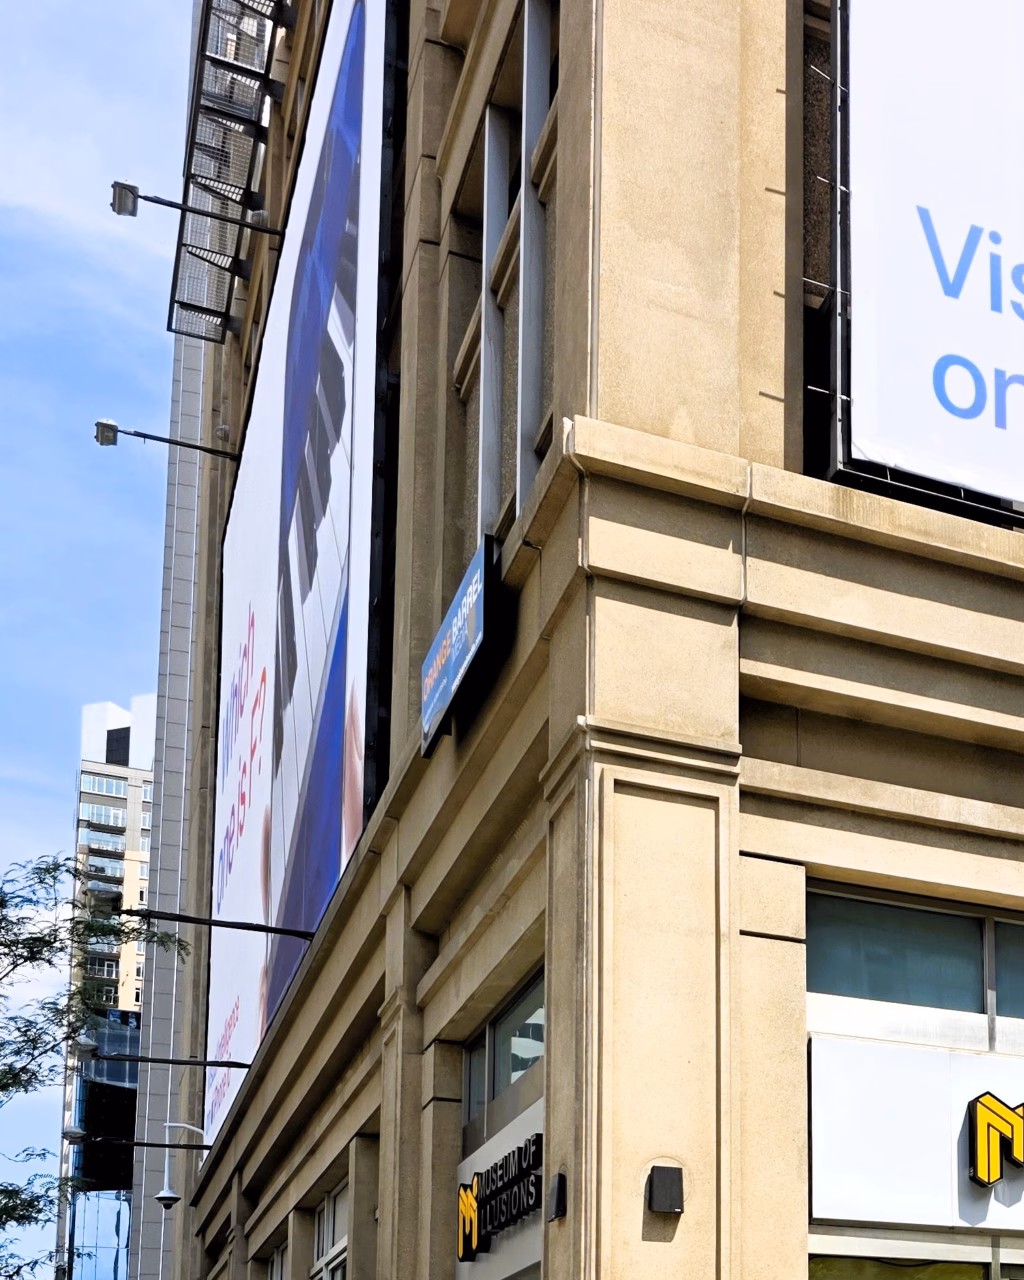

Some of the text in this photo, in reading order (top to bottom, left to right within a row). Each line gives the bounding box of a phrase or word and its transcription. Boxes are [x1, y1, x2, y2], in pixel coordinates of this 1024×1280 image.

[221, 600, 255, 796] Which
[422, 627, 452, 702] ORANGE
[451, 568, 483, 642] BARREL
[217, 803, 236, 915] one
[236, 755, 247, 849] is
[477, 1134, 537, 1201] MUSEUM OF
